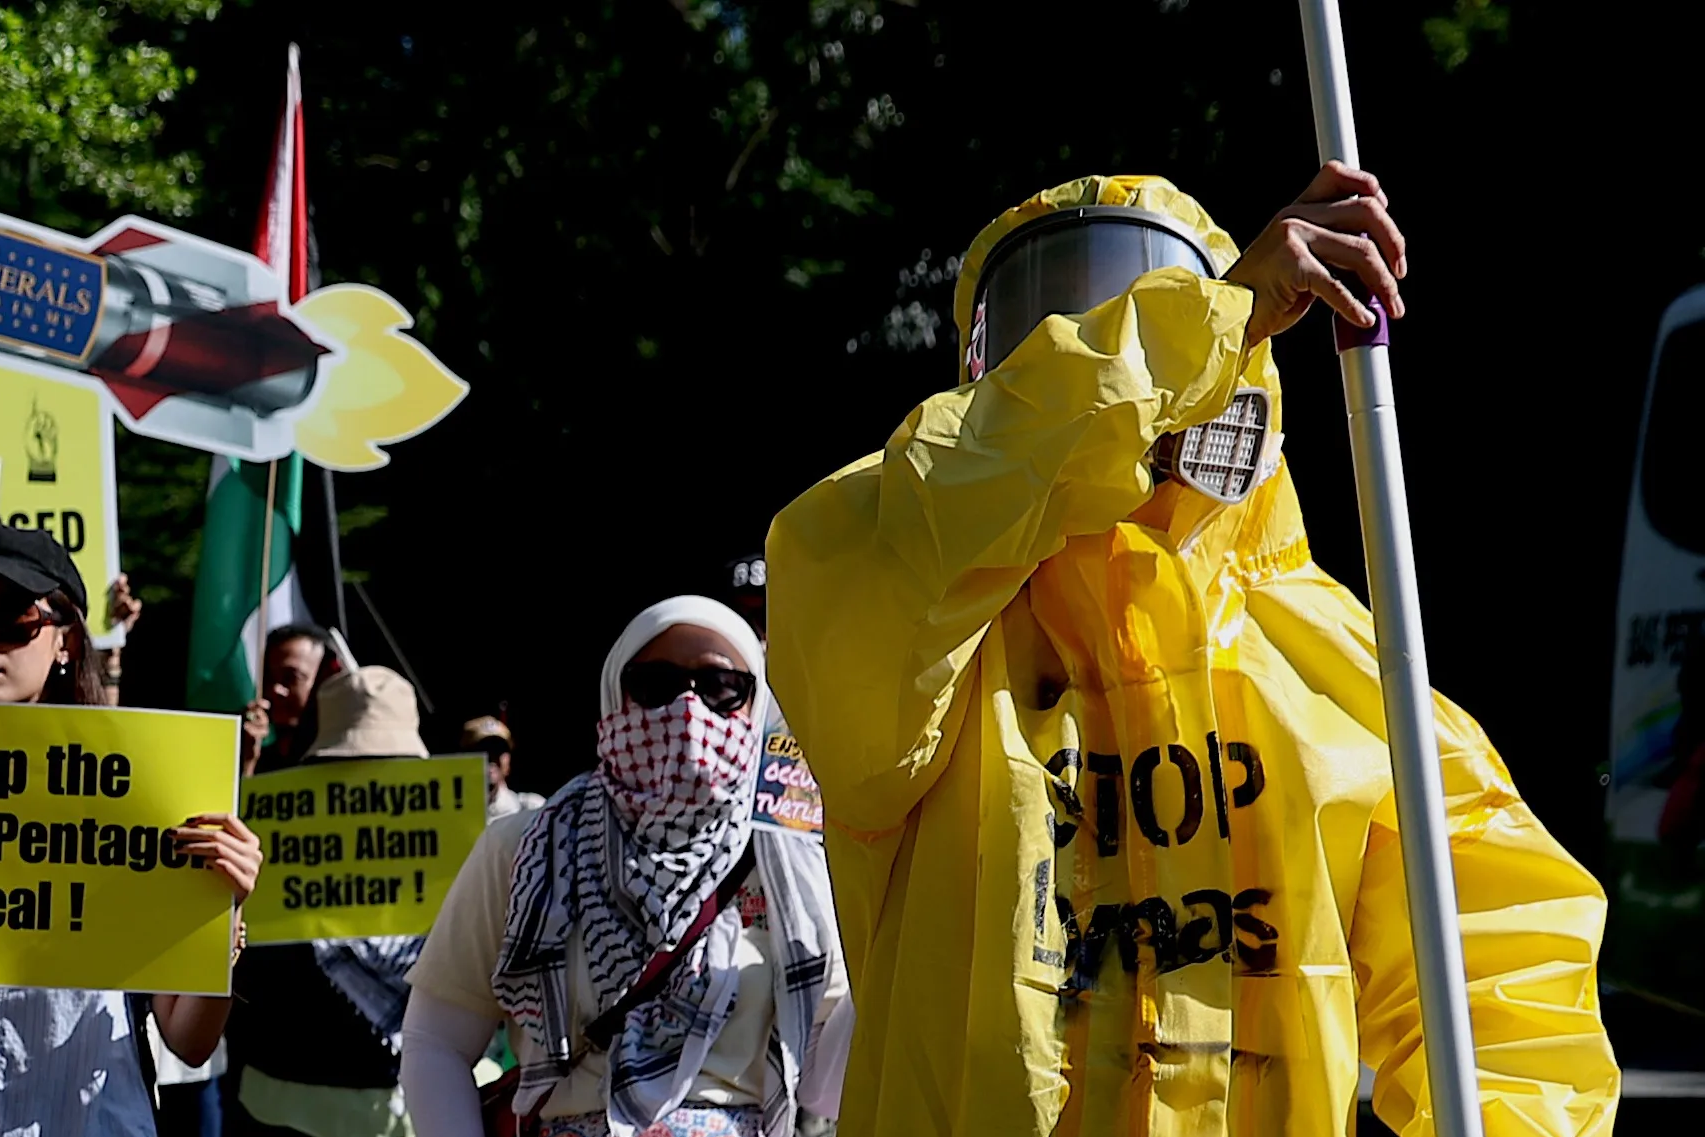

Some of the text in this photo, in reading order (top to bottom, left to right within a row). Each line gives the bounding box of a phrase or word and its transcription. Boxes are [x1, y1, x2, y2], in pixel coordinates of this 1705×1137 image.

[12, 300, 34, 319] IN
[46, 309, 73, 331] MY
[46, 743, 131, 798] the
[1044, 730, 1266, 858] STOP
[243, 775, 464, 822] Jaga Rakyat !
[269, 825, 439, 867] Jaga Alam
[69, 882, 86, 932] !
[283, 868, 425, 910] Sekitar !
